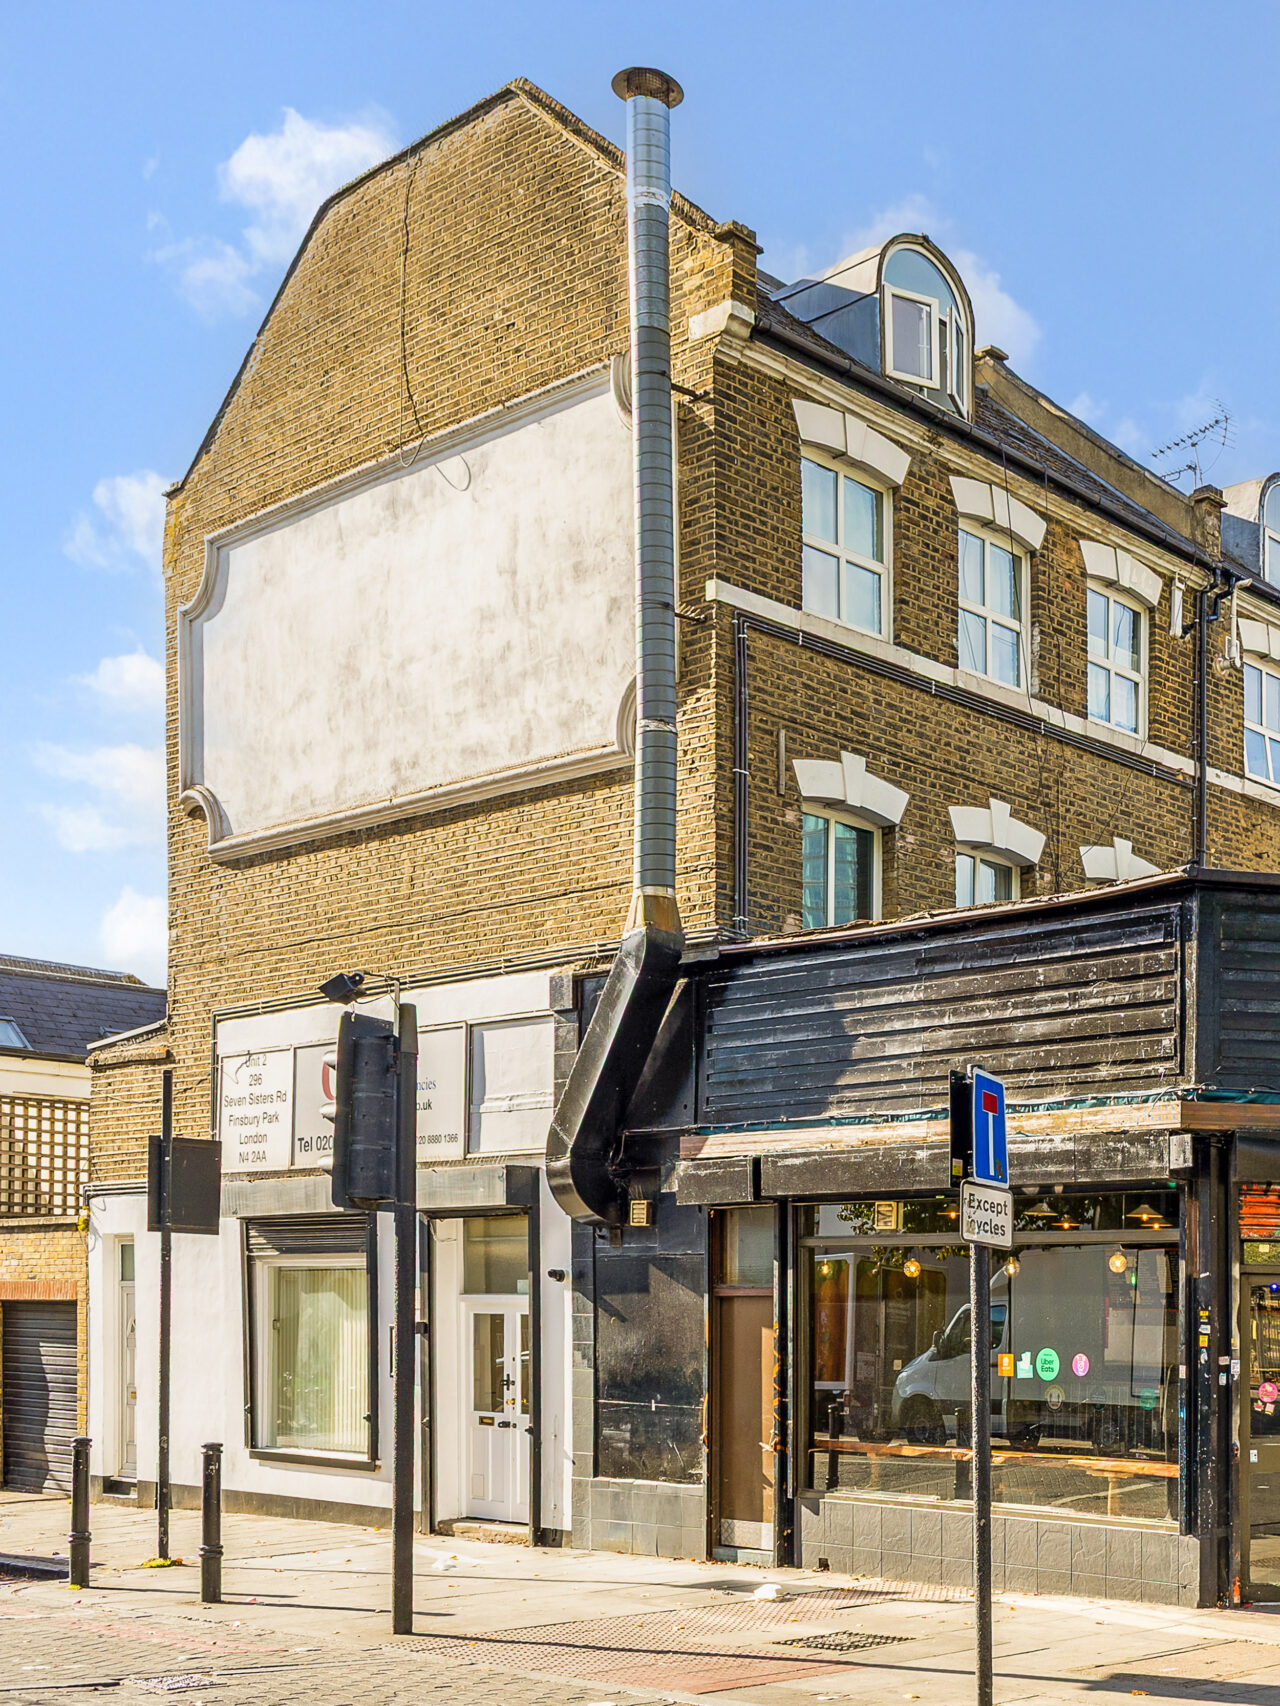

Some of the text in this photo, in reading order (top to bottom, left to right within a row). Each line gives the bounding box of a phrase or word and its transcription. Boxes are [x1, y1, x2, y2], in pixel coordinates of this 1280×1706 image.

[246, 1054, 267, 1068] Unit 2
[249, 1073, 262, 1086] 296
[224, 1090, 287, 1108] Seven Sisters Rd
[229, 1111, 279, 1127] Finsbury Park
[240, 1132, 267, 1144] London
[298, 1136, 313, 1152] Tel
[239, 1150, 267, 1164] N4 2AA
[968, 1192, 1008, 1217] Except
